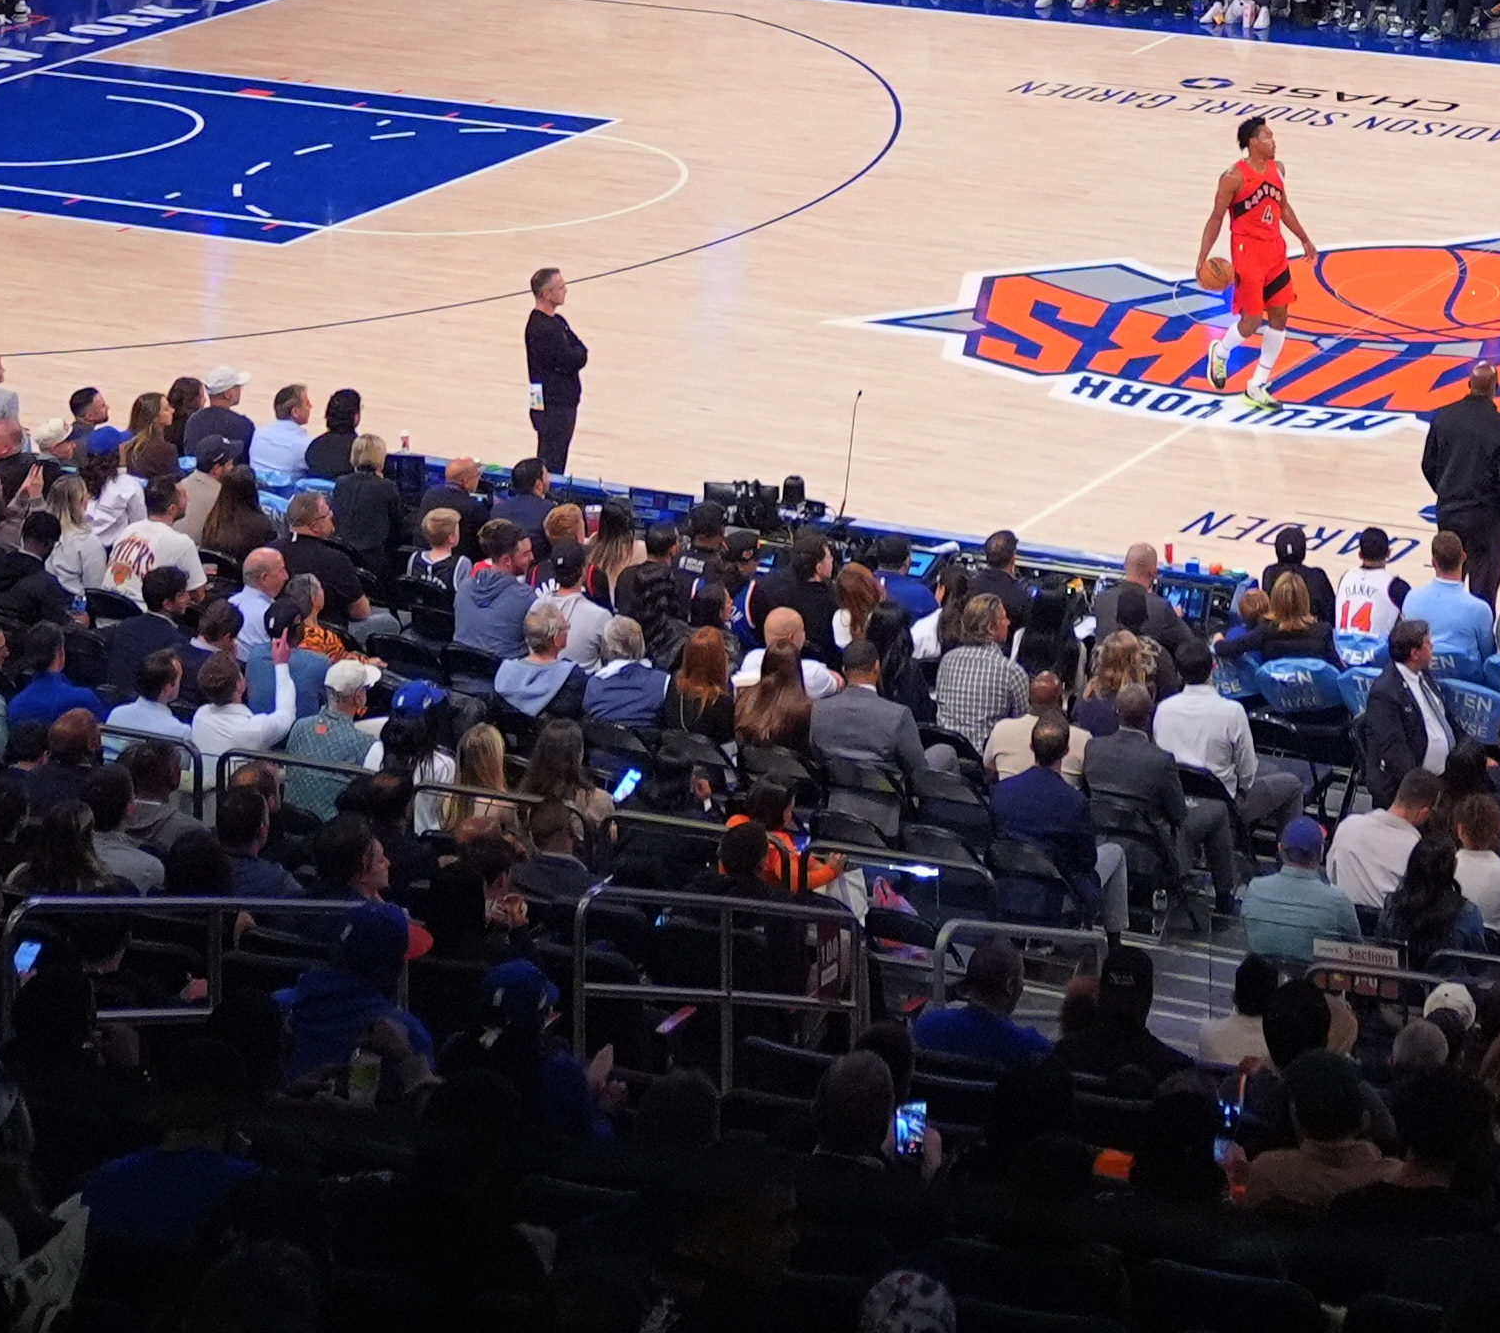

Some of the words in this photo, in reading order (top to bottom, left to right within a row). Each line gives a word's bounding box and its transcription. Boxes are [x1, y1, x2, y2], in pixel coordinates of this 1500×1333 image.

[31, 3, 200, 45] YORK
[1008, 79, 1178, 111] GARDEN
[1247, 82, 1462, 113] CHASE
[1180, 96, 1337, 130] SQUARE
[1261, 204, 1275, 225] 4
[1339, 600, 1373, 635] 14
[1347, 944, 1395, 967] Sections
